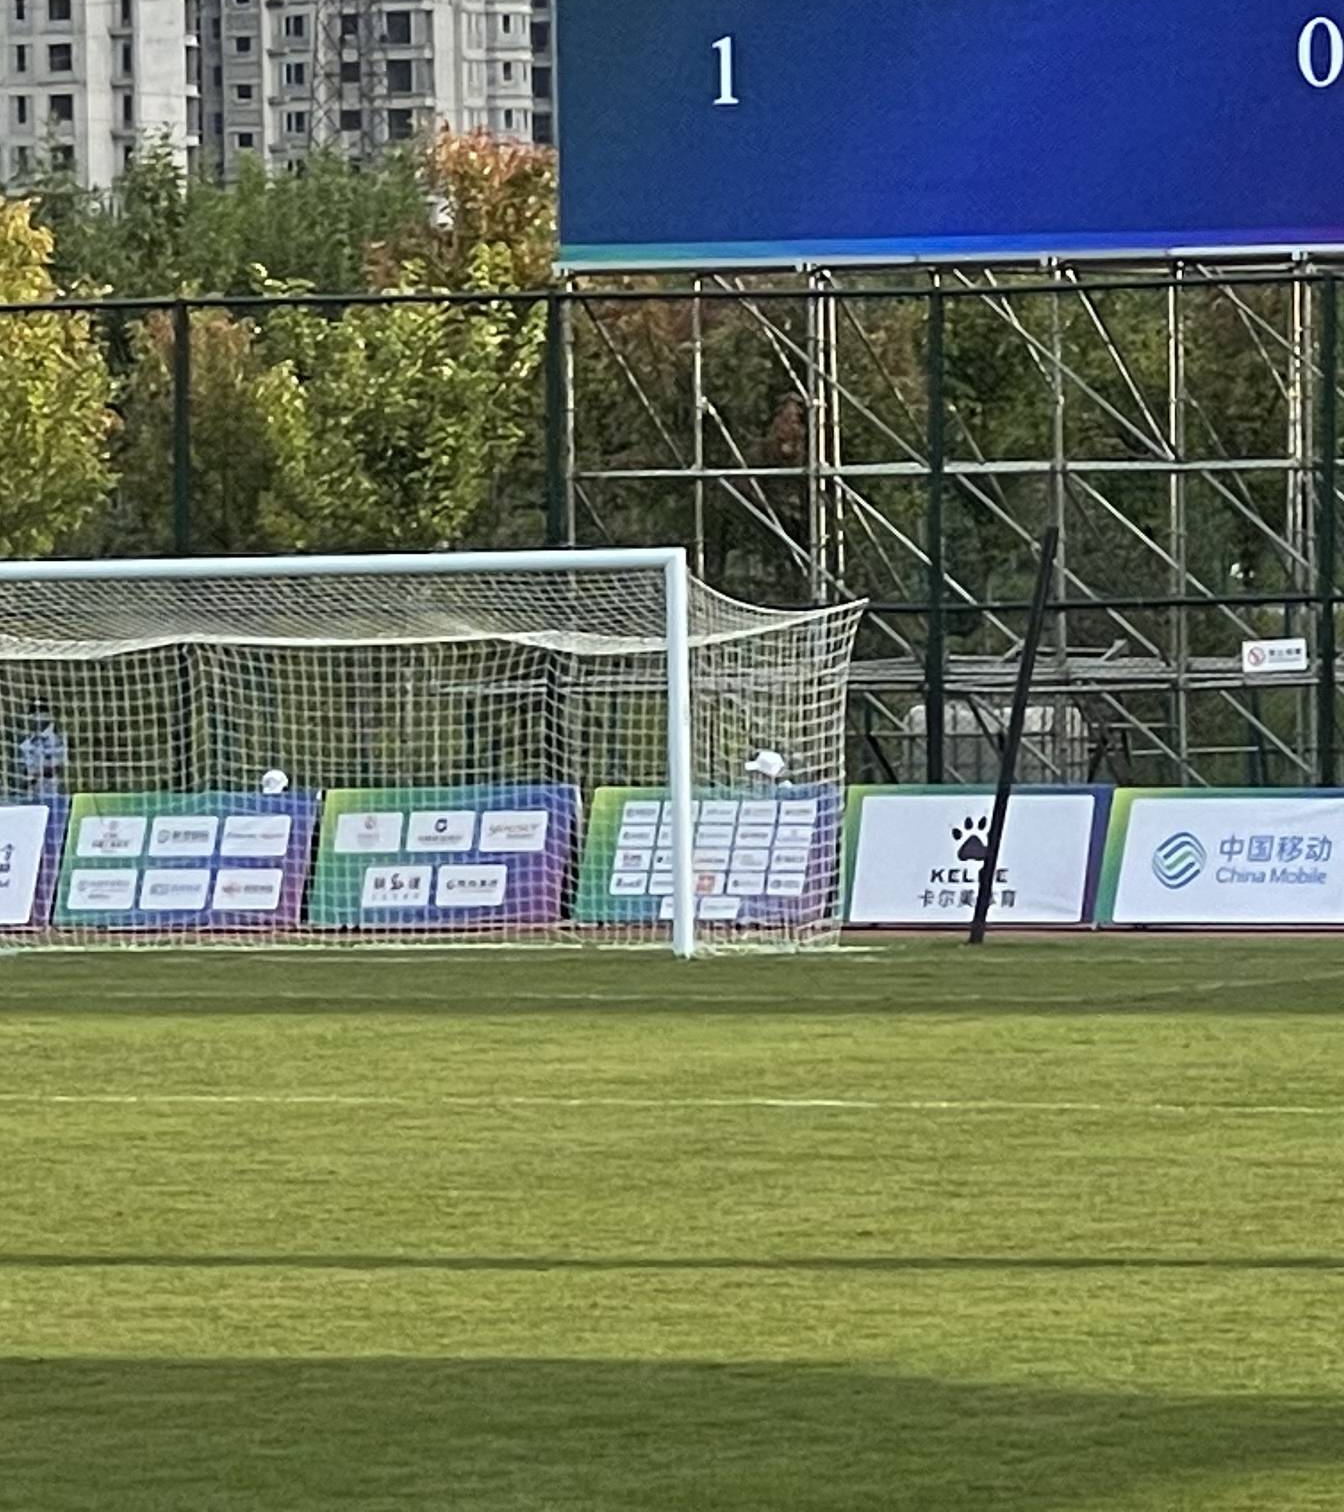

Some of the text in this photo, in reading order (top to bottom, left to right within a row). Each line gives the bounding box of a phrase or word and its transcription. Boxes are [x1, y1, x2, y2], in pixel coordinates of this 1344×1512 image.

[1297, 16, 1344, 88] 0
[712, 36, 739, 105] 1
[1219, 834, 1332, 863] 中国移动
[930, 868, 1009, 883] KELE
[1216, 867, 1327, 884] China Mobile
[918, 889, 1016, 908] 卡尔美育
